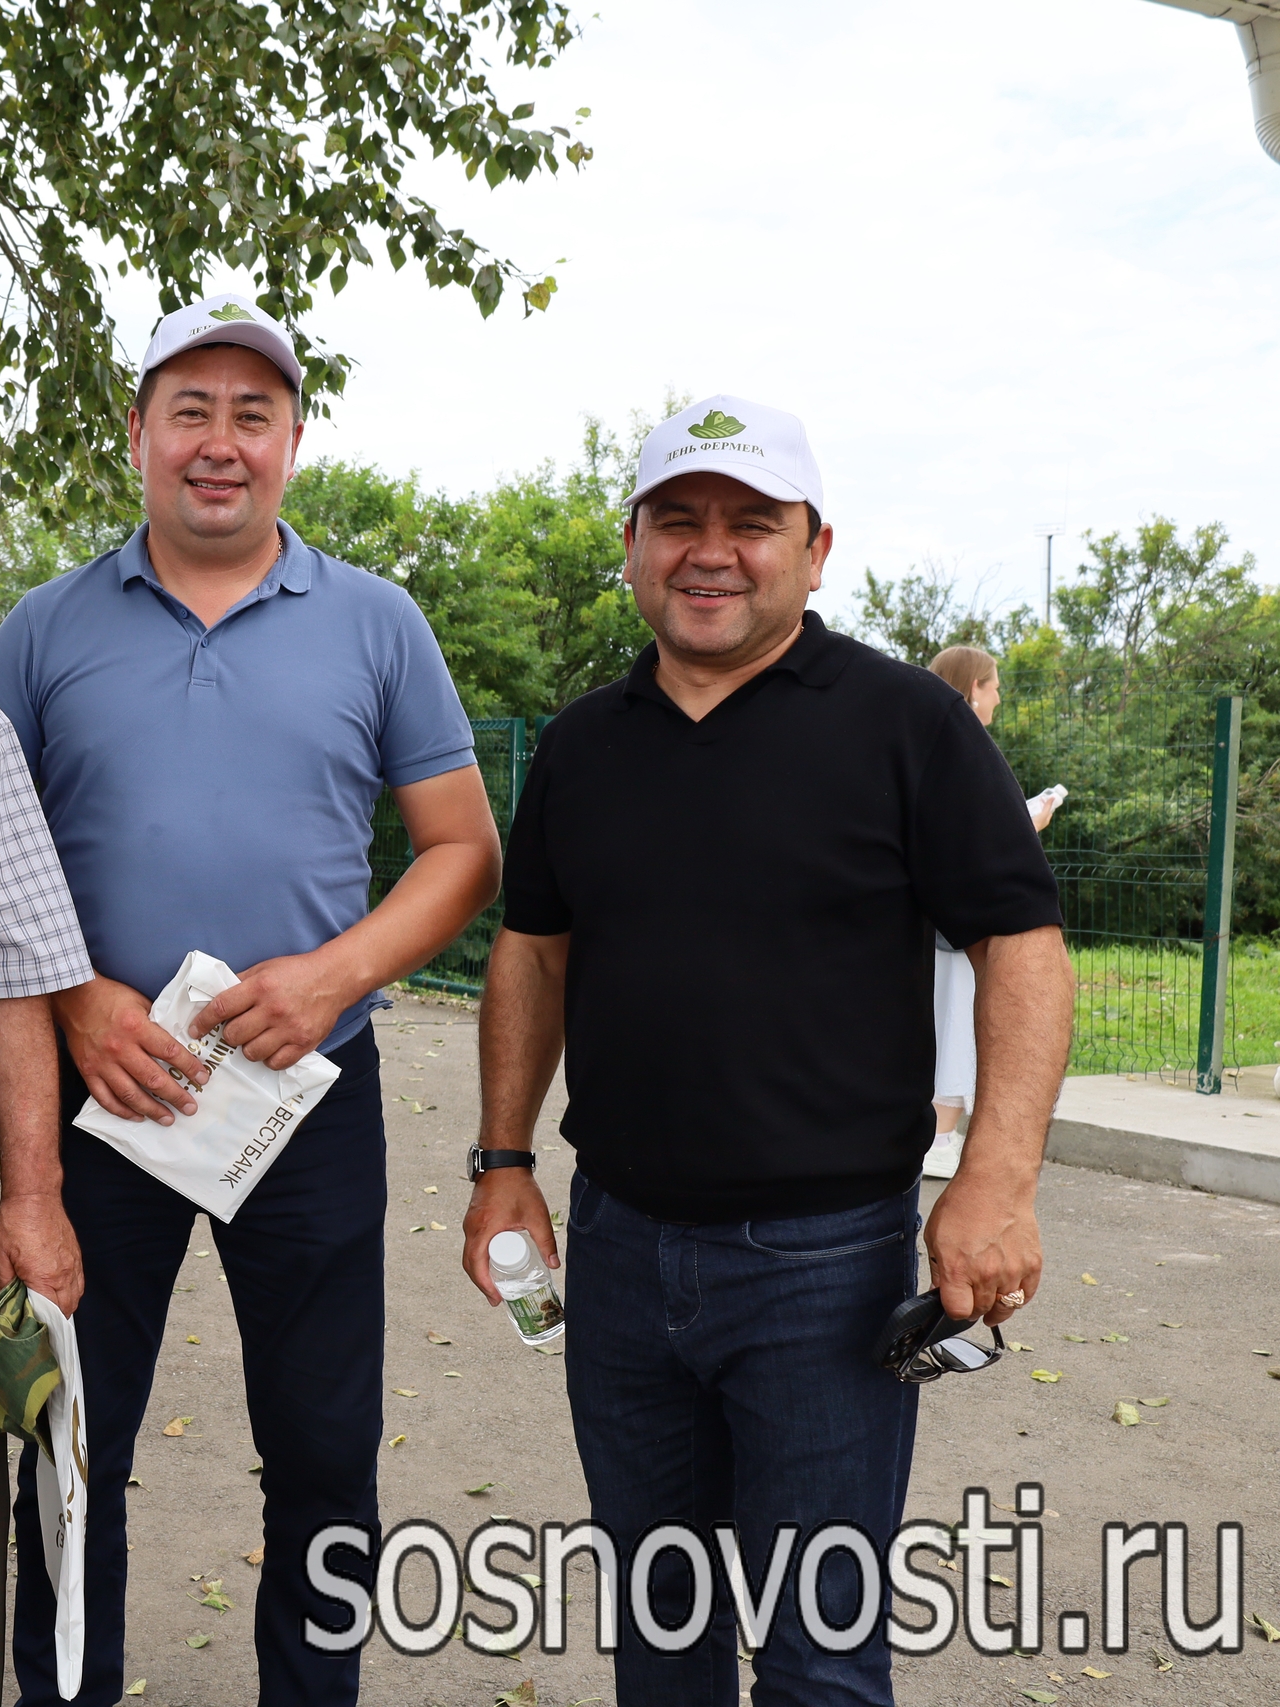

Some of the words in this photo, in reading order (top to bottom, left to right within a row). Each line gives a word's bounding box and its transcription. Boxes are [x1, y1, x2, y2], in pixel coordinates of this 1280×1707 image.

[187, 324, 216, 338] ДЕ
[664, 445, 697, 465] ДЕНЬ
[700, 442, 765, 457] ФЕРМЕРА
